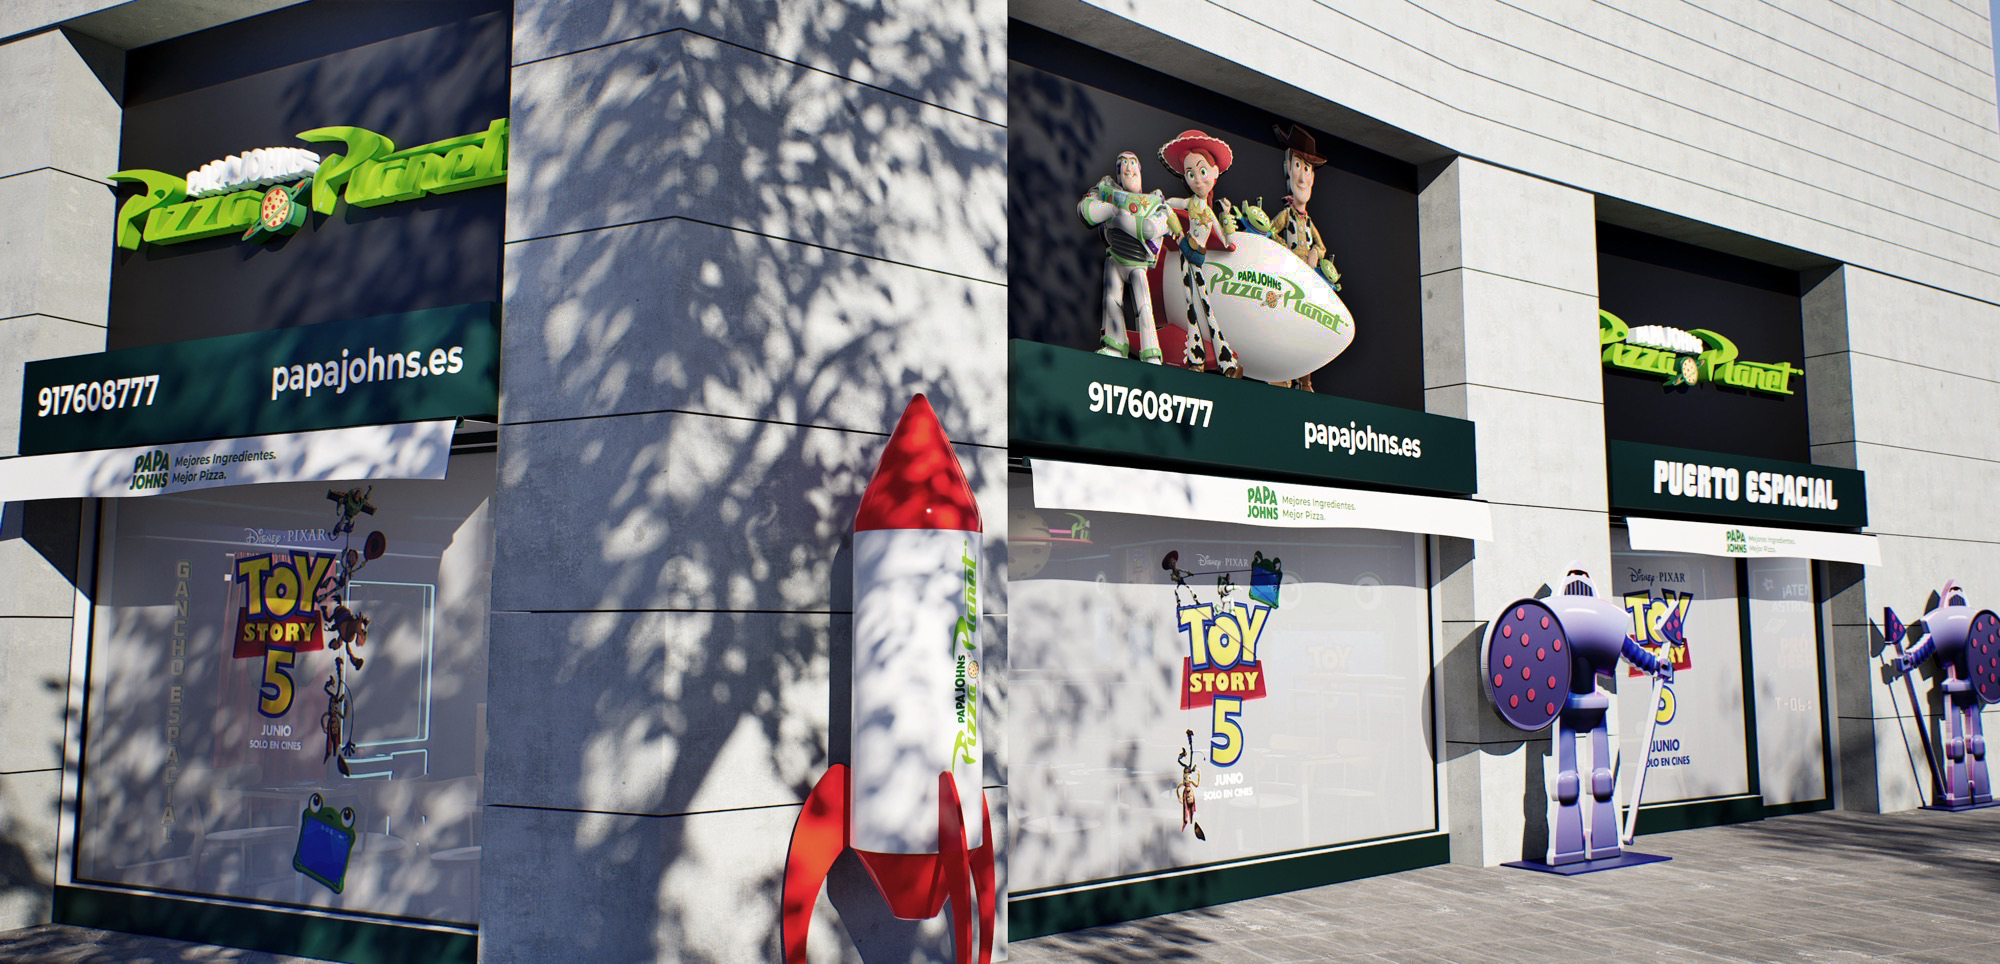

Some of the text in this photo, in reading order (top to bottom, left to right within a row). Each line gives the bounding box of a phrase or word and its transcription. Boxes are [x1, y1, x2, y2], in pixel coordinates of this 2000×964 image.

[107, 118, 510, 251] Pizza Planet
[1204, 262, 1348, 335] Pizza Planet
[1688, 329, 1804, 395] Planet
[37, 345, 464, 418] 917608777 papajohns.es
[1088, 382, 1421, 458] 917608777 papajohns.es
[134, 450, 170, 473] PAPA
[174, 450, 277, 469] Mejores Ingredientes.
[129, 473, 168, 490] JOHNS
[172, 470, 227, 485] Mejor Pizza.
[1653, 459, 1839, 511] PUERTO ESPACIAL
[1247, 486, 1278, 505] PAPA
[1282, 496, 1357, 511] Mejores Ingredientes.
[1247, 505, 1279, 520] JOHNS
[1282, 509, 1303, 520] Mejor
[287, 528, 327, 542] PIXAR
[1726, 529, 1746, 542] PAPA
[1726, 543, 1747, 553] JOHNS
[1225, 557, 1249, 567] PIXAR
[235, 550, 337, 620] TOY
[1659, 571, 1685, 582] PIXAR
[243, 622, 317, 643] STORY
[1177, 602, 1271, 669] TOY
[952, 540, 977, 775] Pizza Planet
[258, 645, 297, 719] 5
[1189, 672, 1258, 692] STORY
[161, 560, 192, 844] GANCHO ESPACIAL
[261, 724, 293, 737] JUNIO
[1210, 694, 1244, 767] 5
[249, 739, 303, 751] SOLO EN CINES
[1651, 739, 1680, 752] JUNIO
[1661, 757, 1670, 766] EN
[1672, 755, 1690, 766] CINES
[1214, 772, 1244, 786] JUNIO
[1203, 787, 1253, 800] SOLO EN CINES
